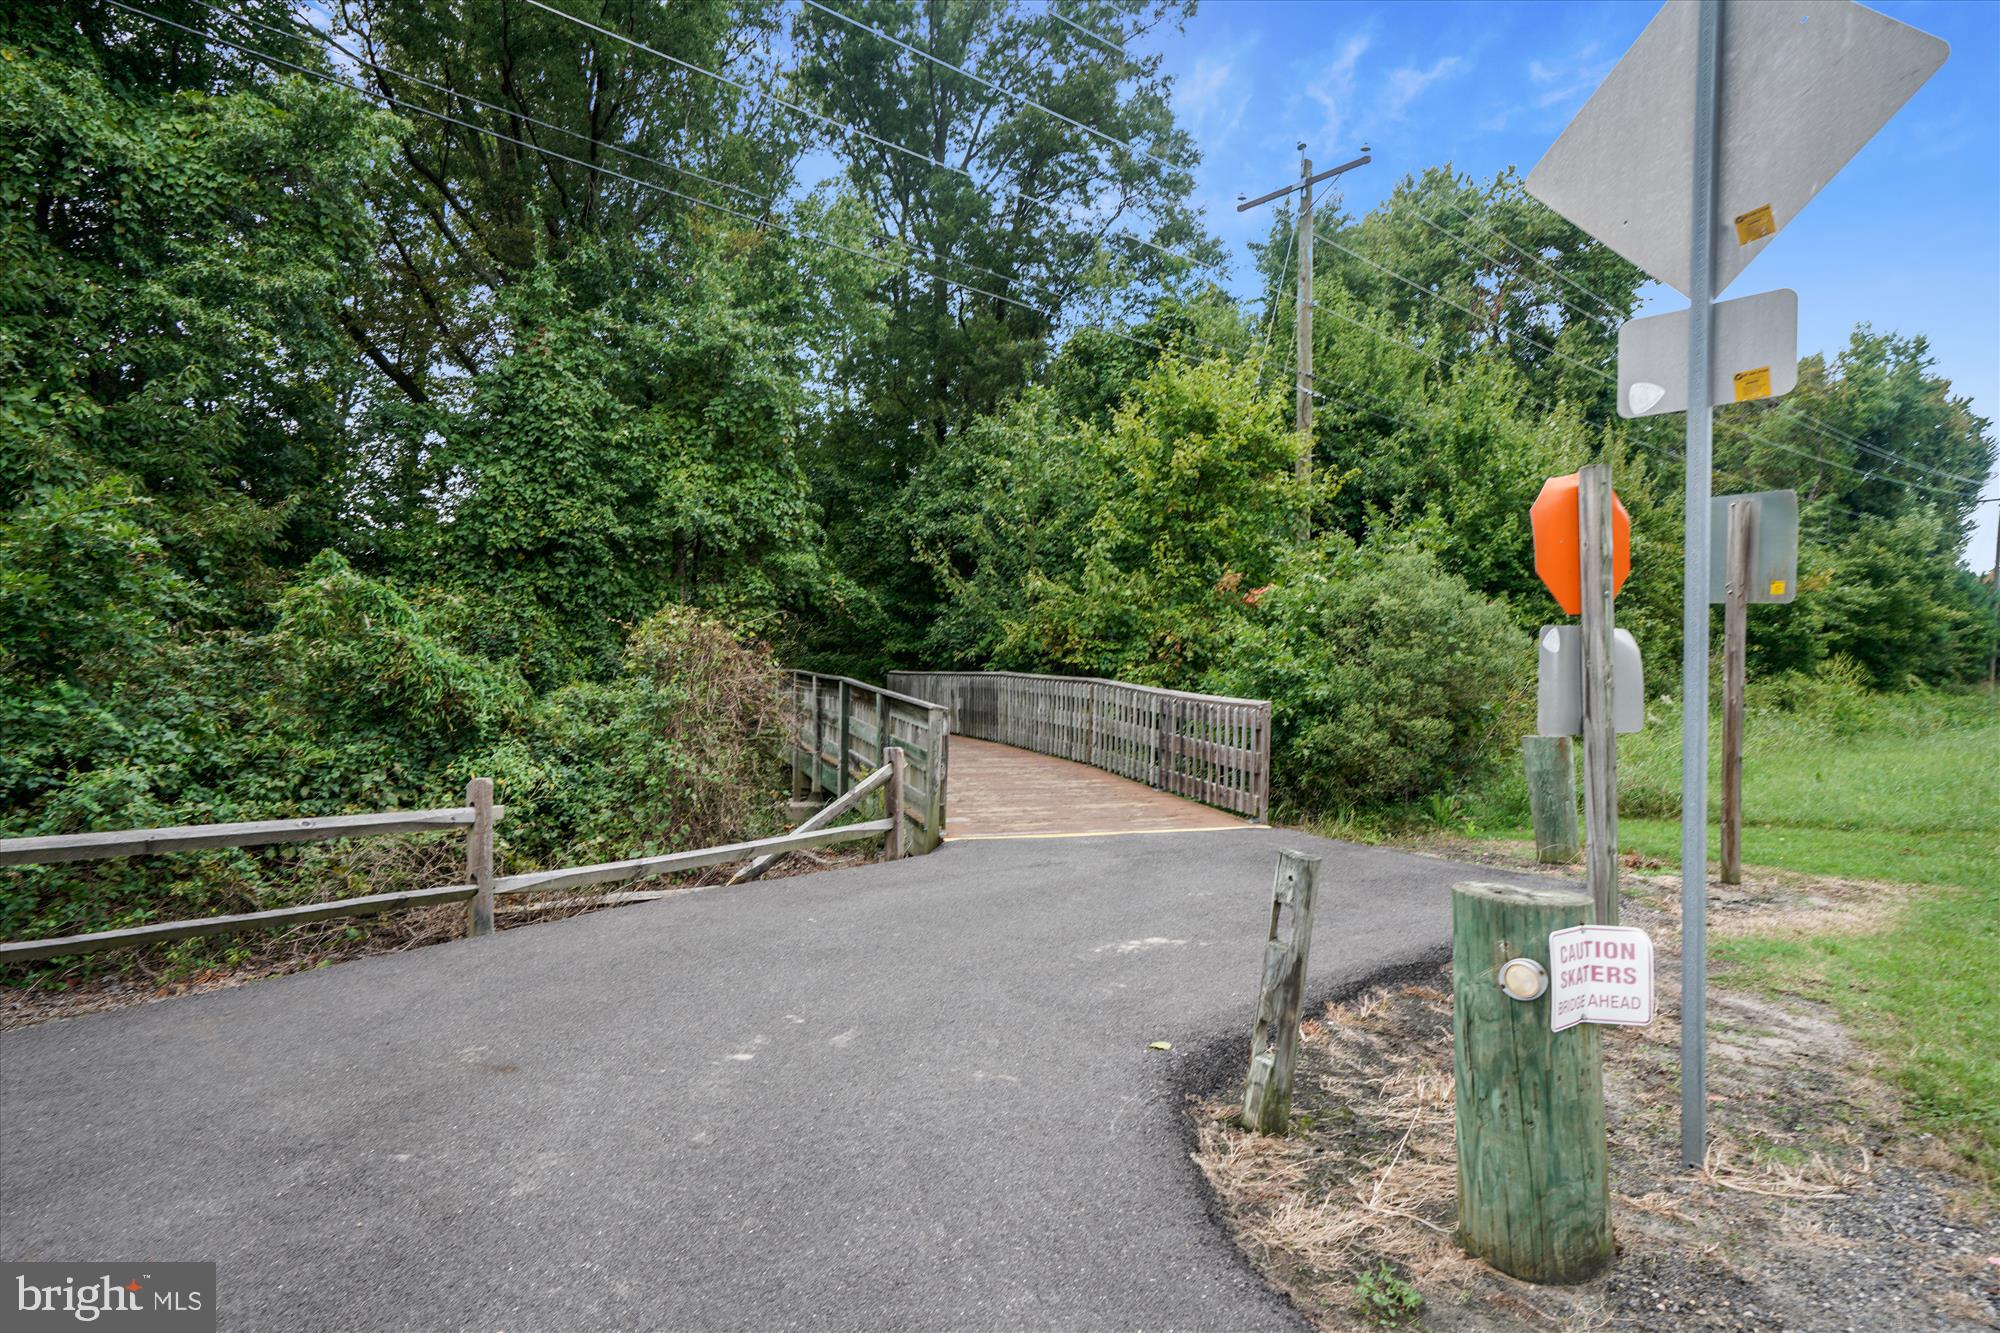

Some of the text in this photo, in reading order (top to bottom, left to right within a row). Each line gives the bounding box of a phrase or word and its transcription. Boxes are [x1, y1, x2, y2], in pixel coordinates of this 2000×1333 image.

[1560, 941, 1635, 964] CAUTION
[1560, 965, 1637, 989] SKATERS
[1587, 994, 1642, 1010] AHEAD
